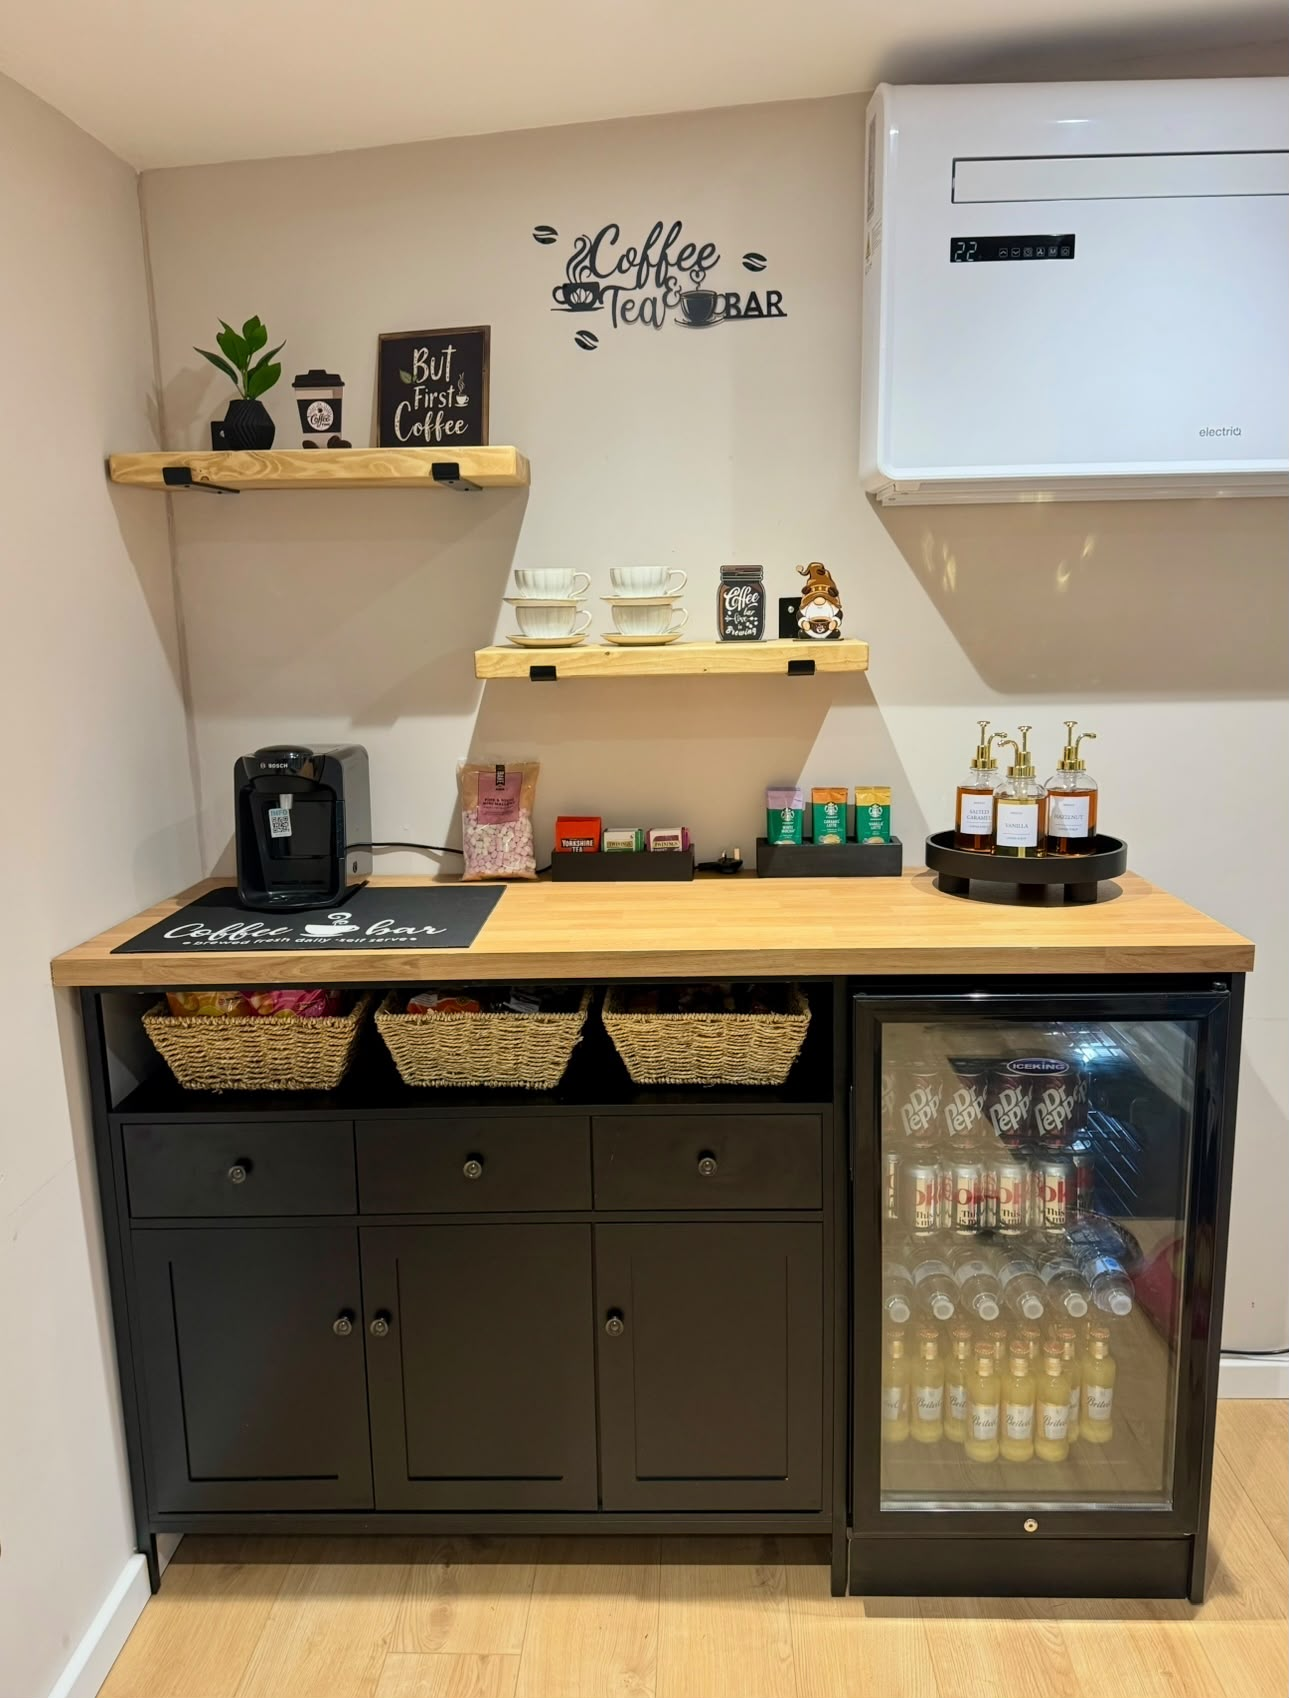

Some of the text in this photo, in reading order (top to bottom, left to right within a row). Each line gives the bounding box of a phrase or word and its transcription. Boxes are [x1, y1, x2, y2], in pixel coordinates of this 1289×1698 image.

[591, 221, 720, 289] Coffee
[954, 241, 978, 262] 22
[600, 276, 787, 331] Tea & BAR
[414, 385, 455, 410] First
[310, 412, 331, 428] Coffee
[394, 401, 469, 442] Coffee
[723, 585, 760, 611] Coffee
[561, 839, 594, 848] YORKSHIRE
[163, 919, 447, 941] Coffee bar
[1012, 1062, 1066, 1071] ICEKING
[910, 1084, 933, 1114] Dr
[953, 1084, 977, 1114] Dr
[999, 1084, 1023, 1114] Dr
[1042, 1084, 1067, 1114] Dr
[961, 1210, 977, 1219] Thi
[1047, 1207, 1065, 1217] This
